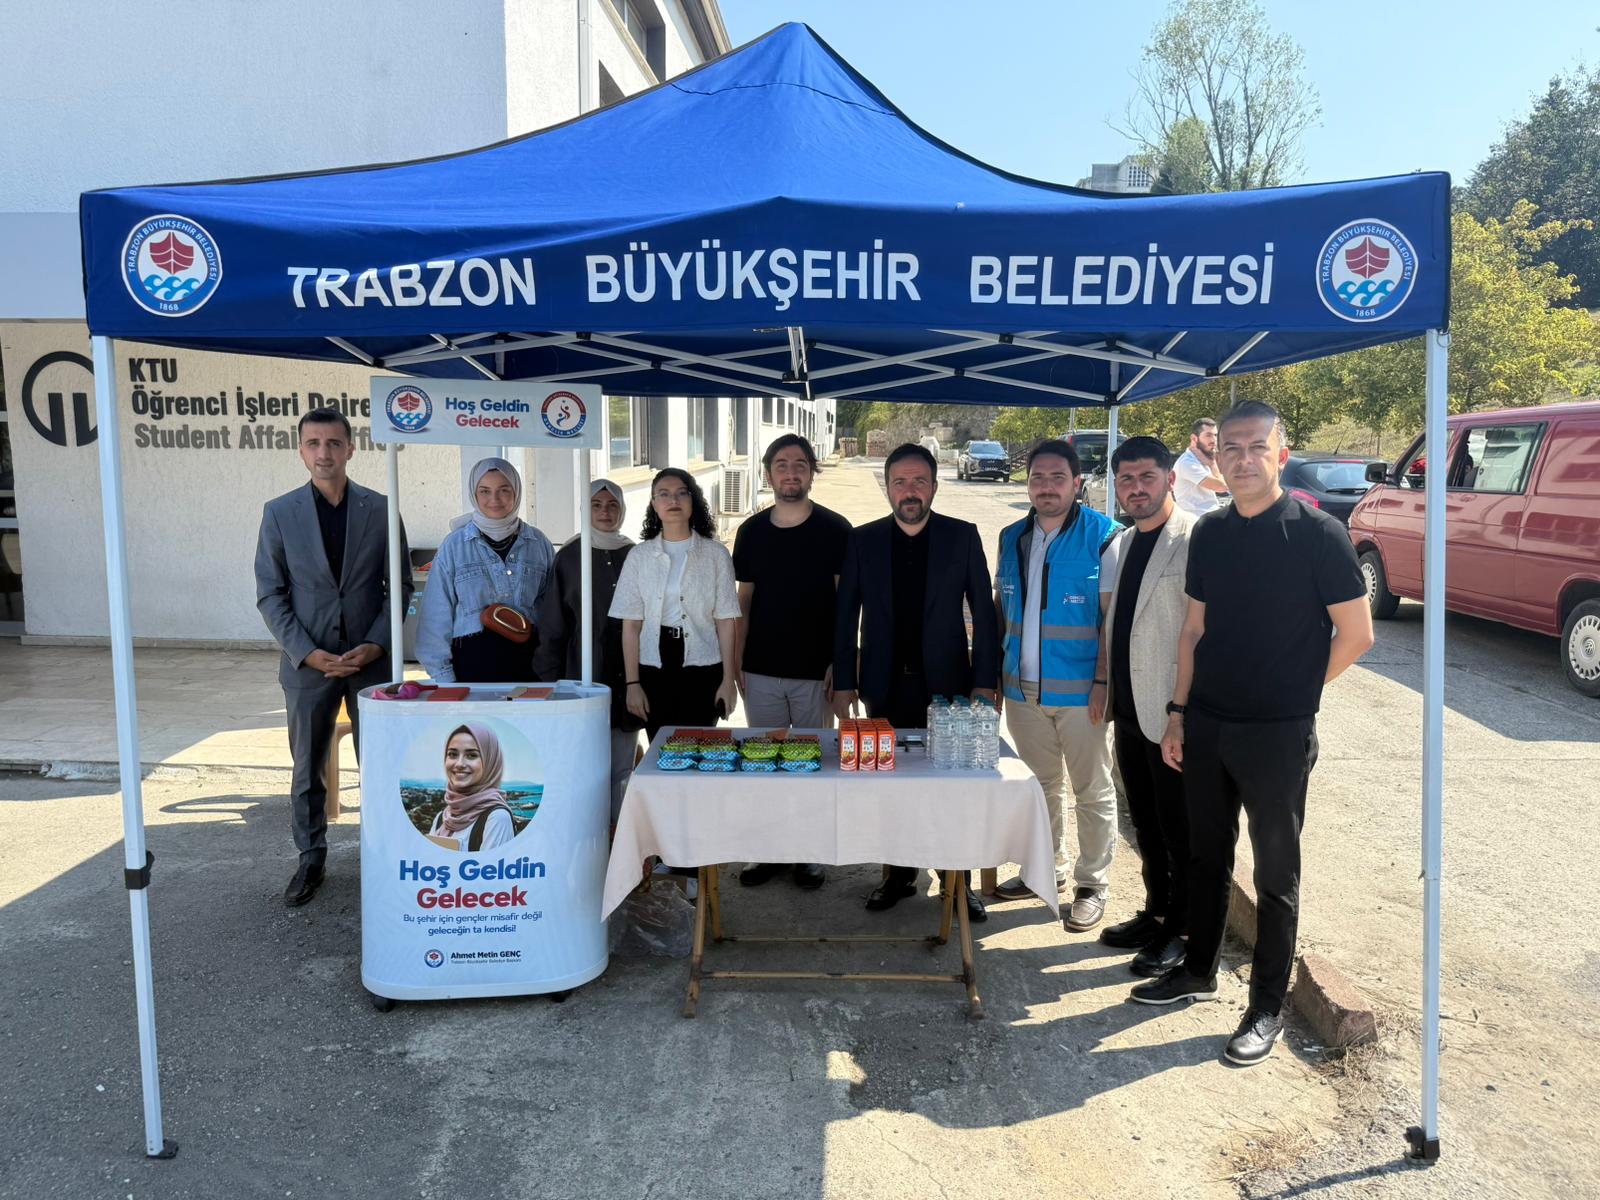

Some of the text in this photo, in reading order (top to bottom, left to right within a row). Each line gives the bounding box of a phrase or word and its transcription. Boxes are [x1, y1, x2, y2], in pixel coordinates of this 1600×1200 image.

[128, 219, 217, 281] TRABZON BÜYÜKŞEHİR BELEDİYESİ
[1322, 224, 1413, 283] TRABZON BÜYÜKŞEHİR BELEDİYESİ
[287, 240, 1276, 312] TRABZON BÜYÜKŞEHİR BELEDİYESİ
[159, 302, 179, 311] 1868
[1355, 308, 1376, 317] 1868
[129, 358, 178, 383] KTU
[132, 384, 228, 420] Öğrenci
[236, 386, 300, 422] İşleri
[445, 397, 476, 414] Hoş
[480, 399, 530, 413] Geldin
[456, 413, 520, 428] Gelecek
[134, 423, 231, 449] Student
[238, 425, 299, 450] Affai
[399, 857, 546, 888] Hoş Geldin
[416, 885, 528, 909] Gelecek
[403, 911, 543, 925] Bu şehir için gençler misafir değil
[427, 924, 517, 937] geleceğin ta kendisi!
[450, 952, 477, 960] Ahmet
[480, 951, 498, 959] Metin
[499, 950, 522, 958] GENÇ
